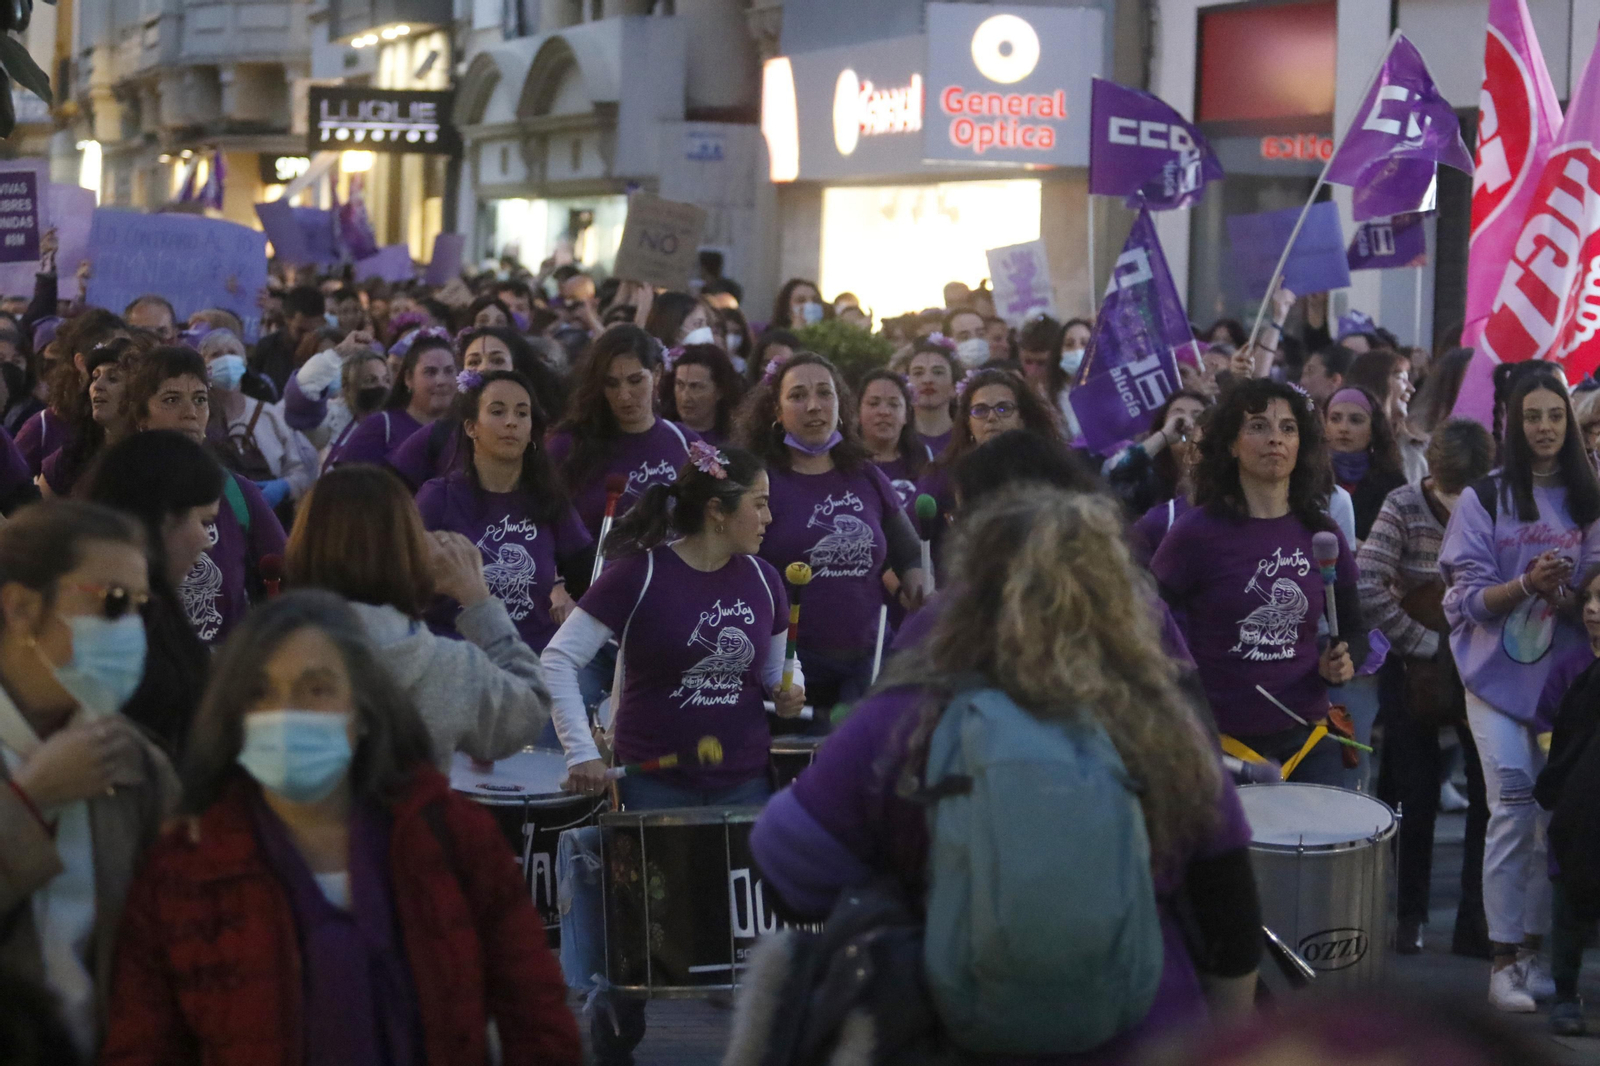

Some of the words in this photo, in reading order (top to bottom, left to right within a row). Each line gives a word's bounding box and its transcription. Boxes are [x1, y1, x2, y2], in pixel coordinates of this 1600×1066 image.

[320, 99, 437, 123] LUQUE
[941, 87, 1067, 119] General
[950, 119, 1056, 153] Optica
[639, 229, 679, 255] NO
[1304, 935, 1364, 962] OZZI
